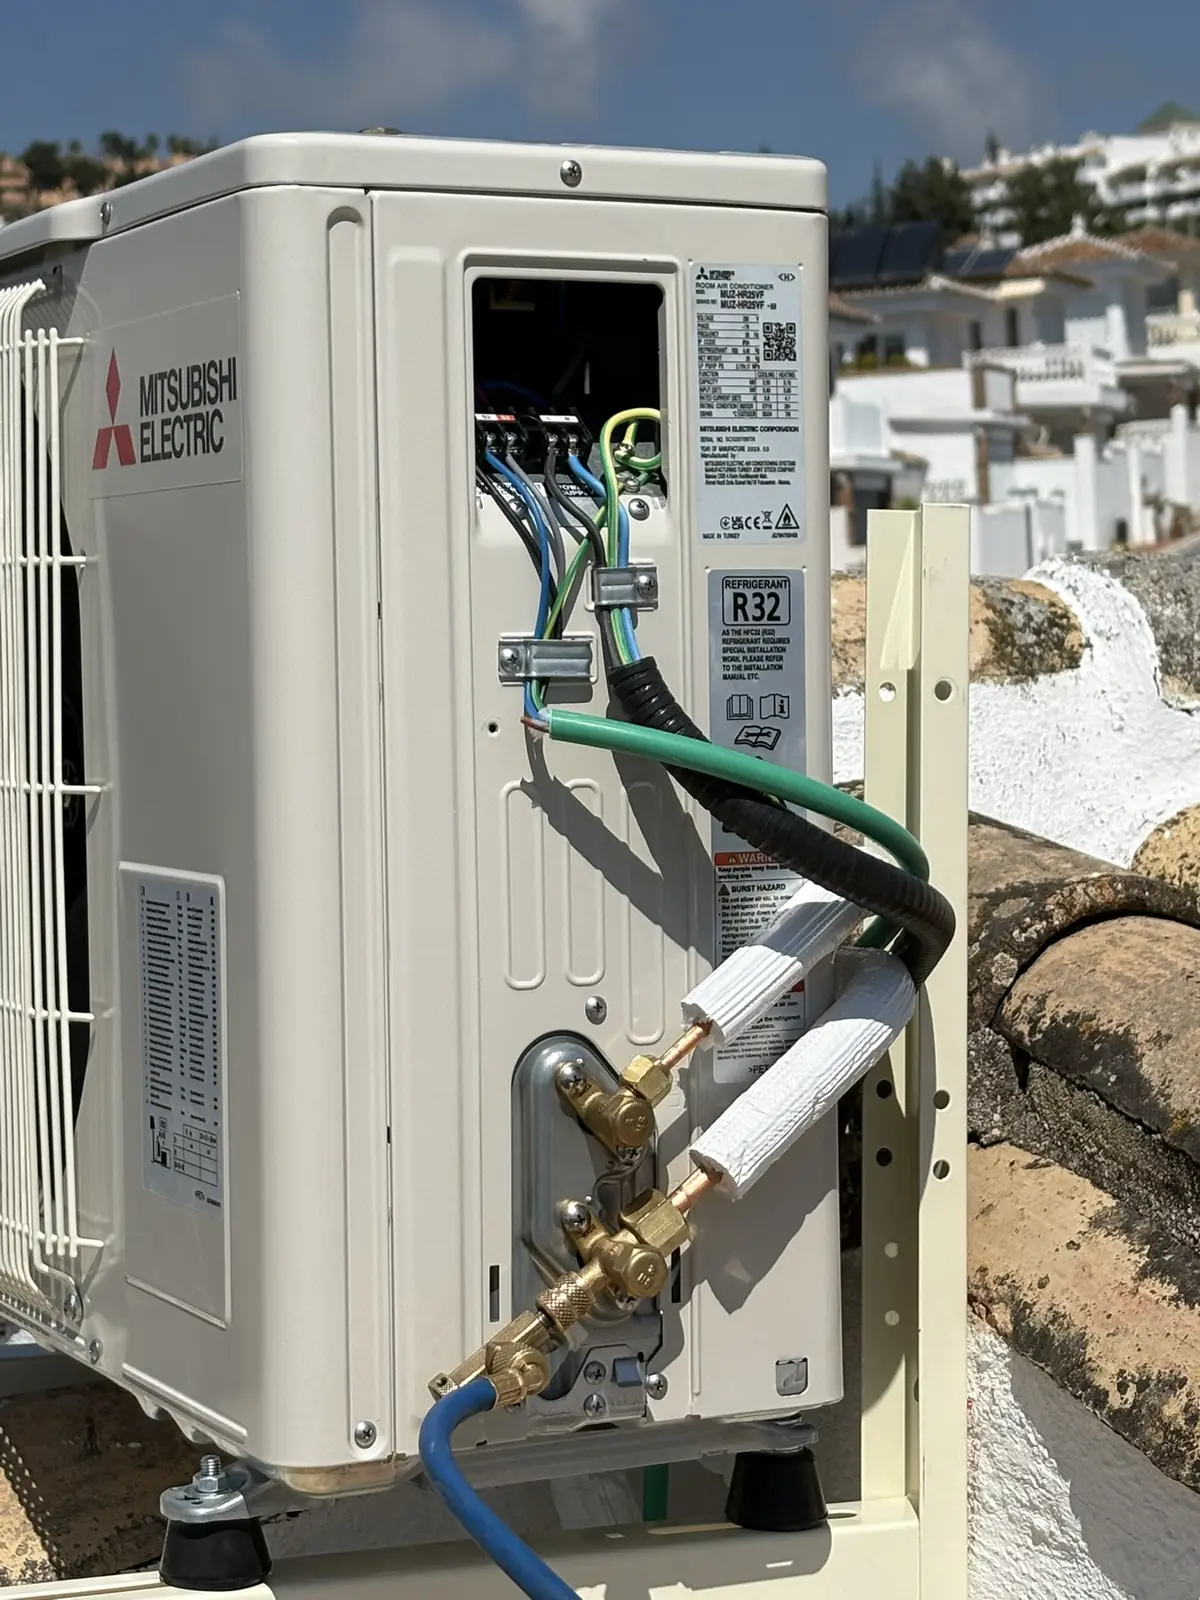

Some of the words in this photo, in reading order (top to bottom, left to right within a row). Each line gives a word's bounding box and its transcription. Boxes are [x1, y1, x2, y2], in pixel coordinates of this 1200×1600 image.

[140, 357, 237, 417] MITSUBISHI
[140, 408, 224, 463] ELECTRIC
[725, 580, 788, 589] REFRIGERANT
[733, 592, 781, 622] R32
[738, 853, 772, 863] WARN
